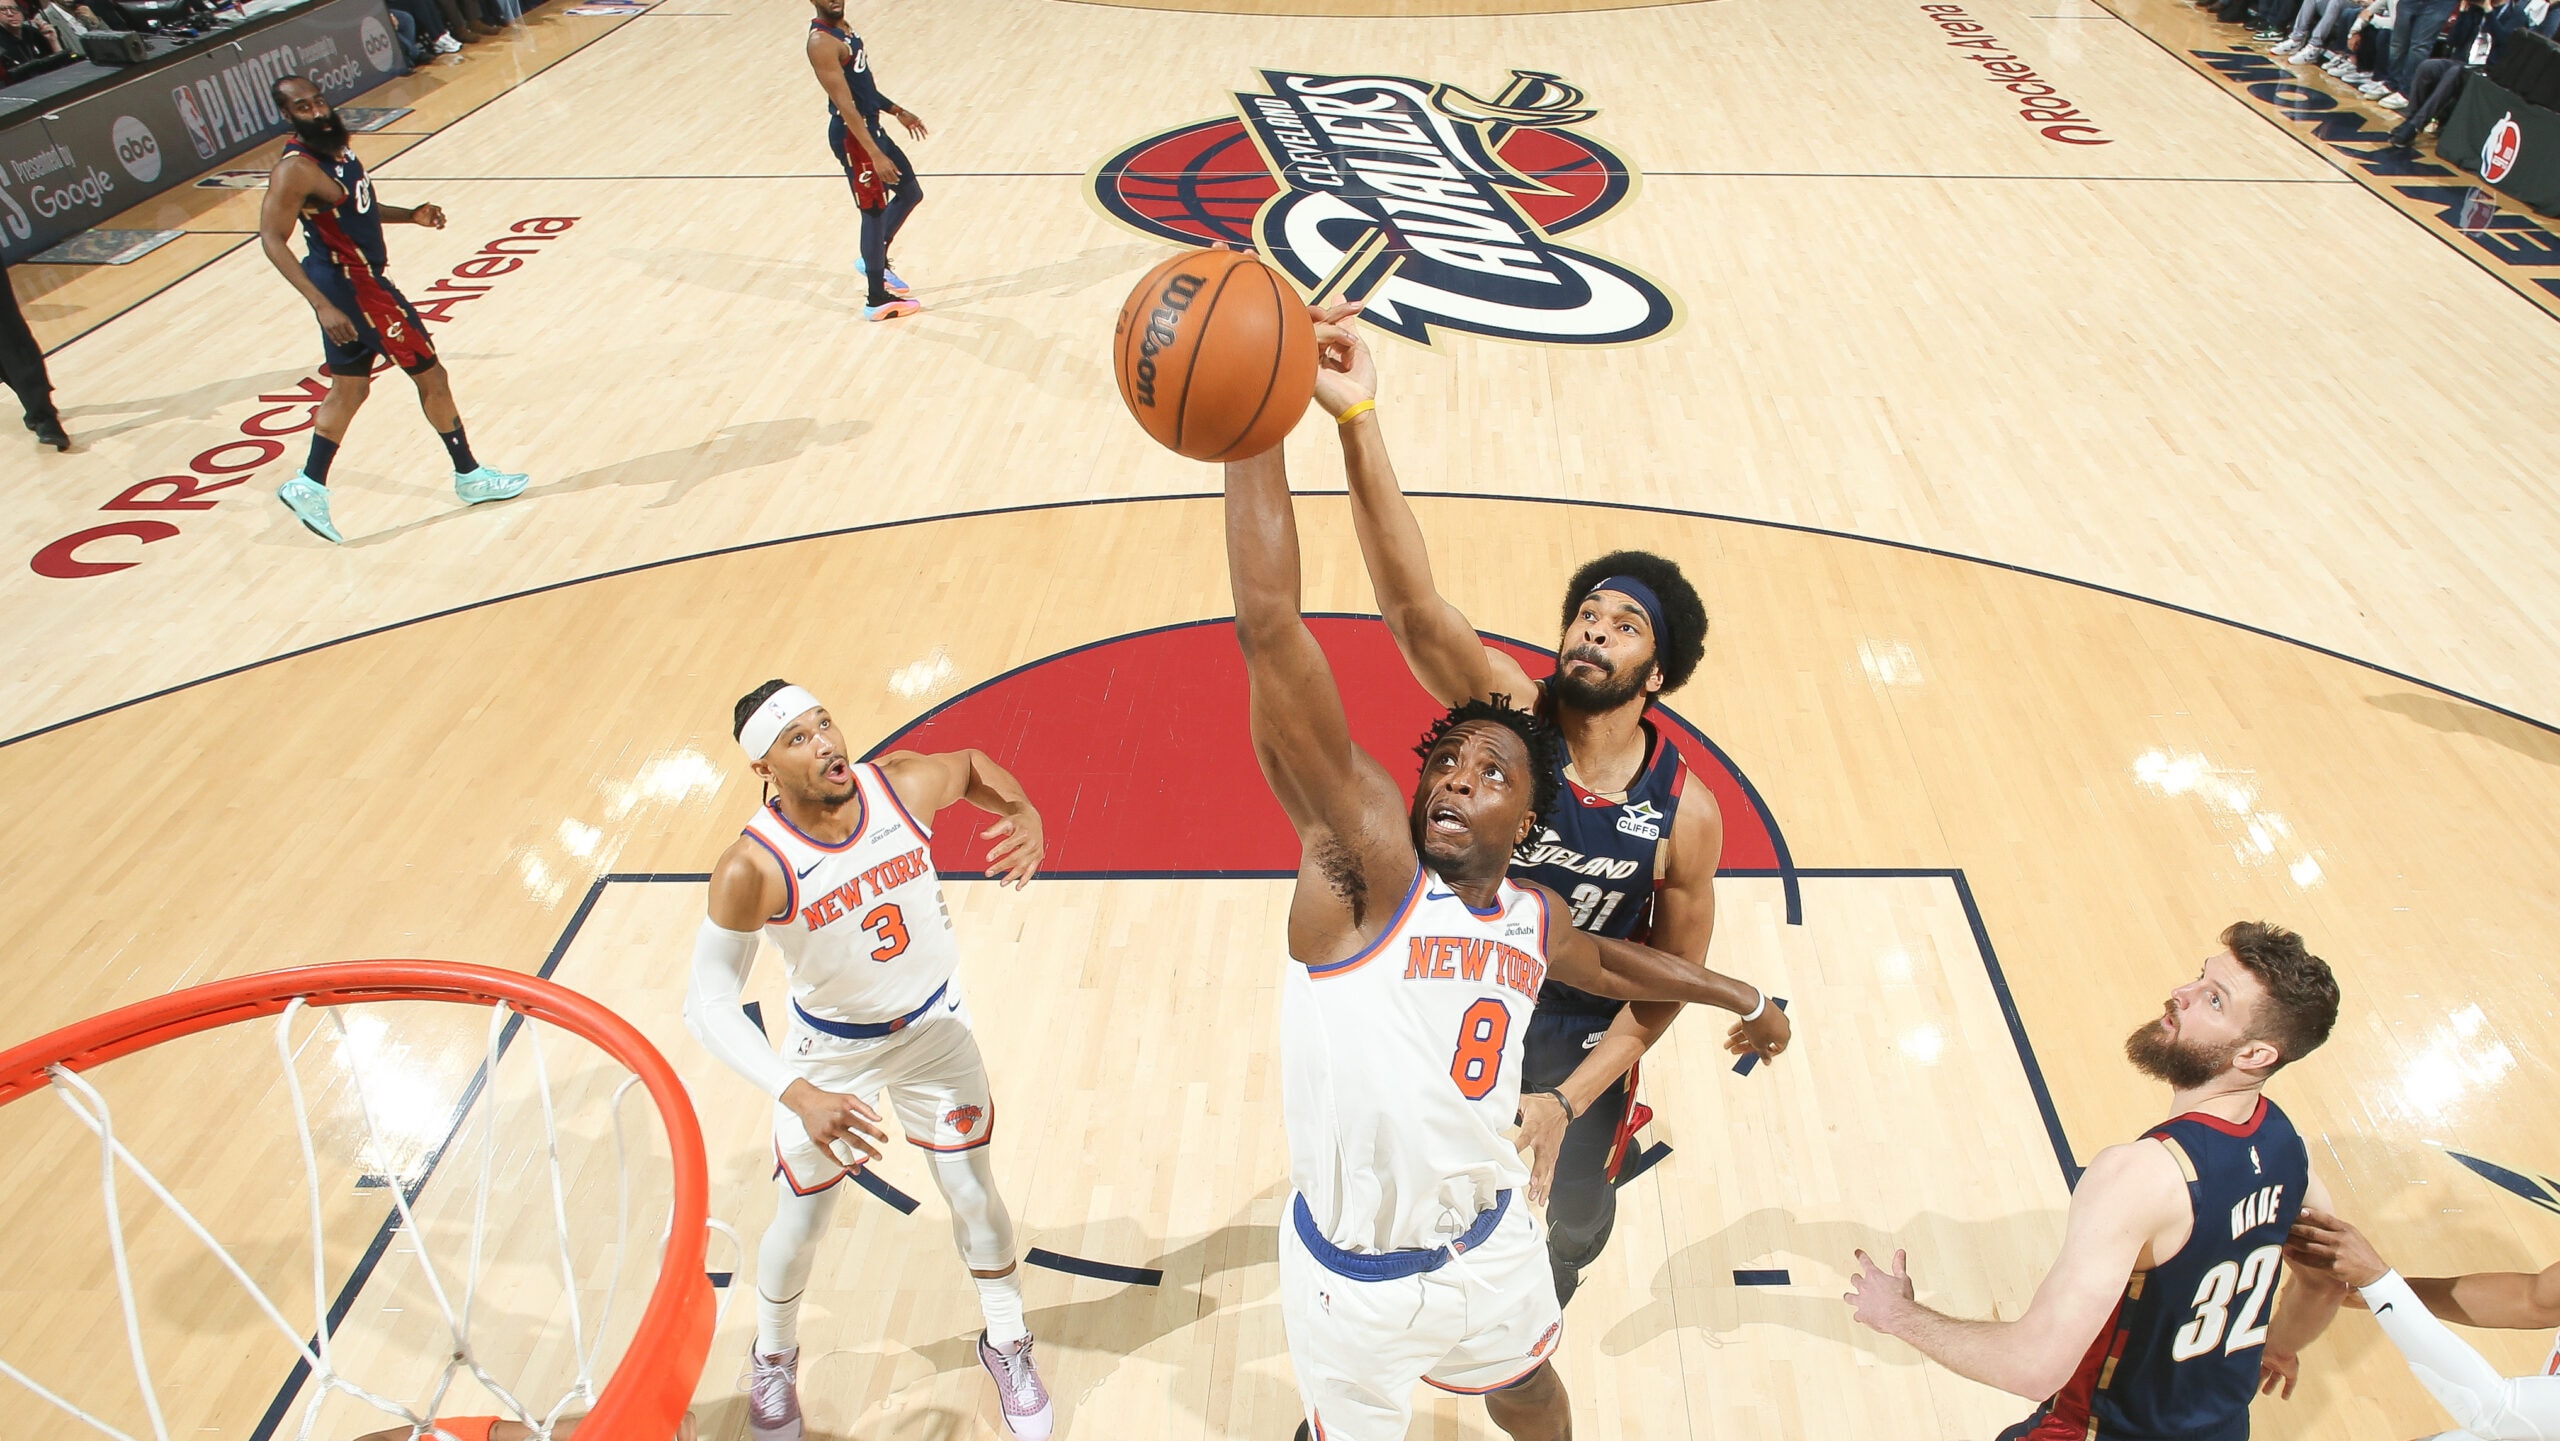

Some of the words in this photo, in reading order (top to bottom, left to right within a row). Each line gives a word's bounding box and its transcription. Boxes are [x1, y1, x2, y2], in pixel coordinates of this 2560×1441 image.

[365, 33, 389, 55] abc
[1920, 4, 2009, 51] Arena
[309, 54, 362, 94] Google
[1961, 54, 2092, 122] Rocket
[119, 135, 156, 164] abc
[1254, 97, 1345, 187] CLEVELAND
[31, 165, 115, 218] Google
[410, 216, 582, 322] Arena
[1136, 273, 1207, 408] Wilson
[1618, 820, 1658, 837] CLIFFS
[800, 876, 863, 932] NEW
[861, 846, 929, 898] YORK
[1568, 882, 1626, 932] 31
[860, 902, 911, 963] 3
[1403, 936, 1495, 981] NEW
[1495, 941, 1545, 1006] YORK
[1449, 997, 1512, 1101] 8
[2230, 1184, 2284, 1241] WADE
[2171, 1244, 2283, 1362] 32
